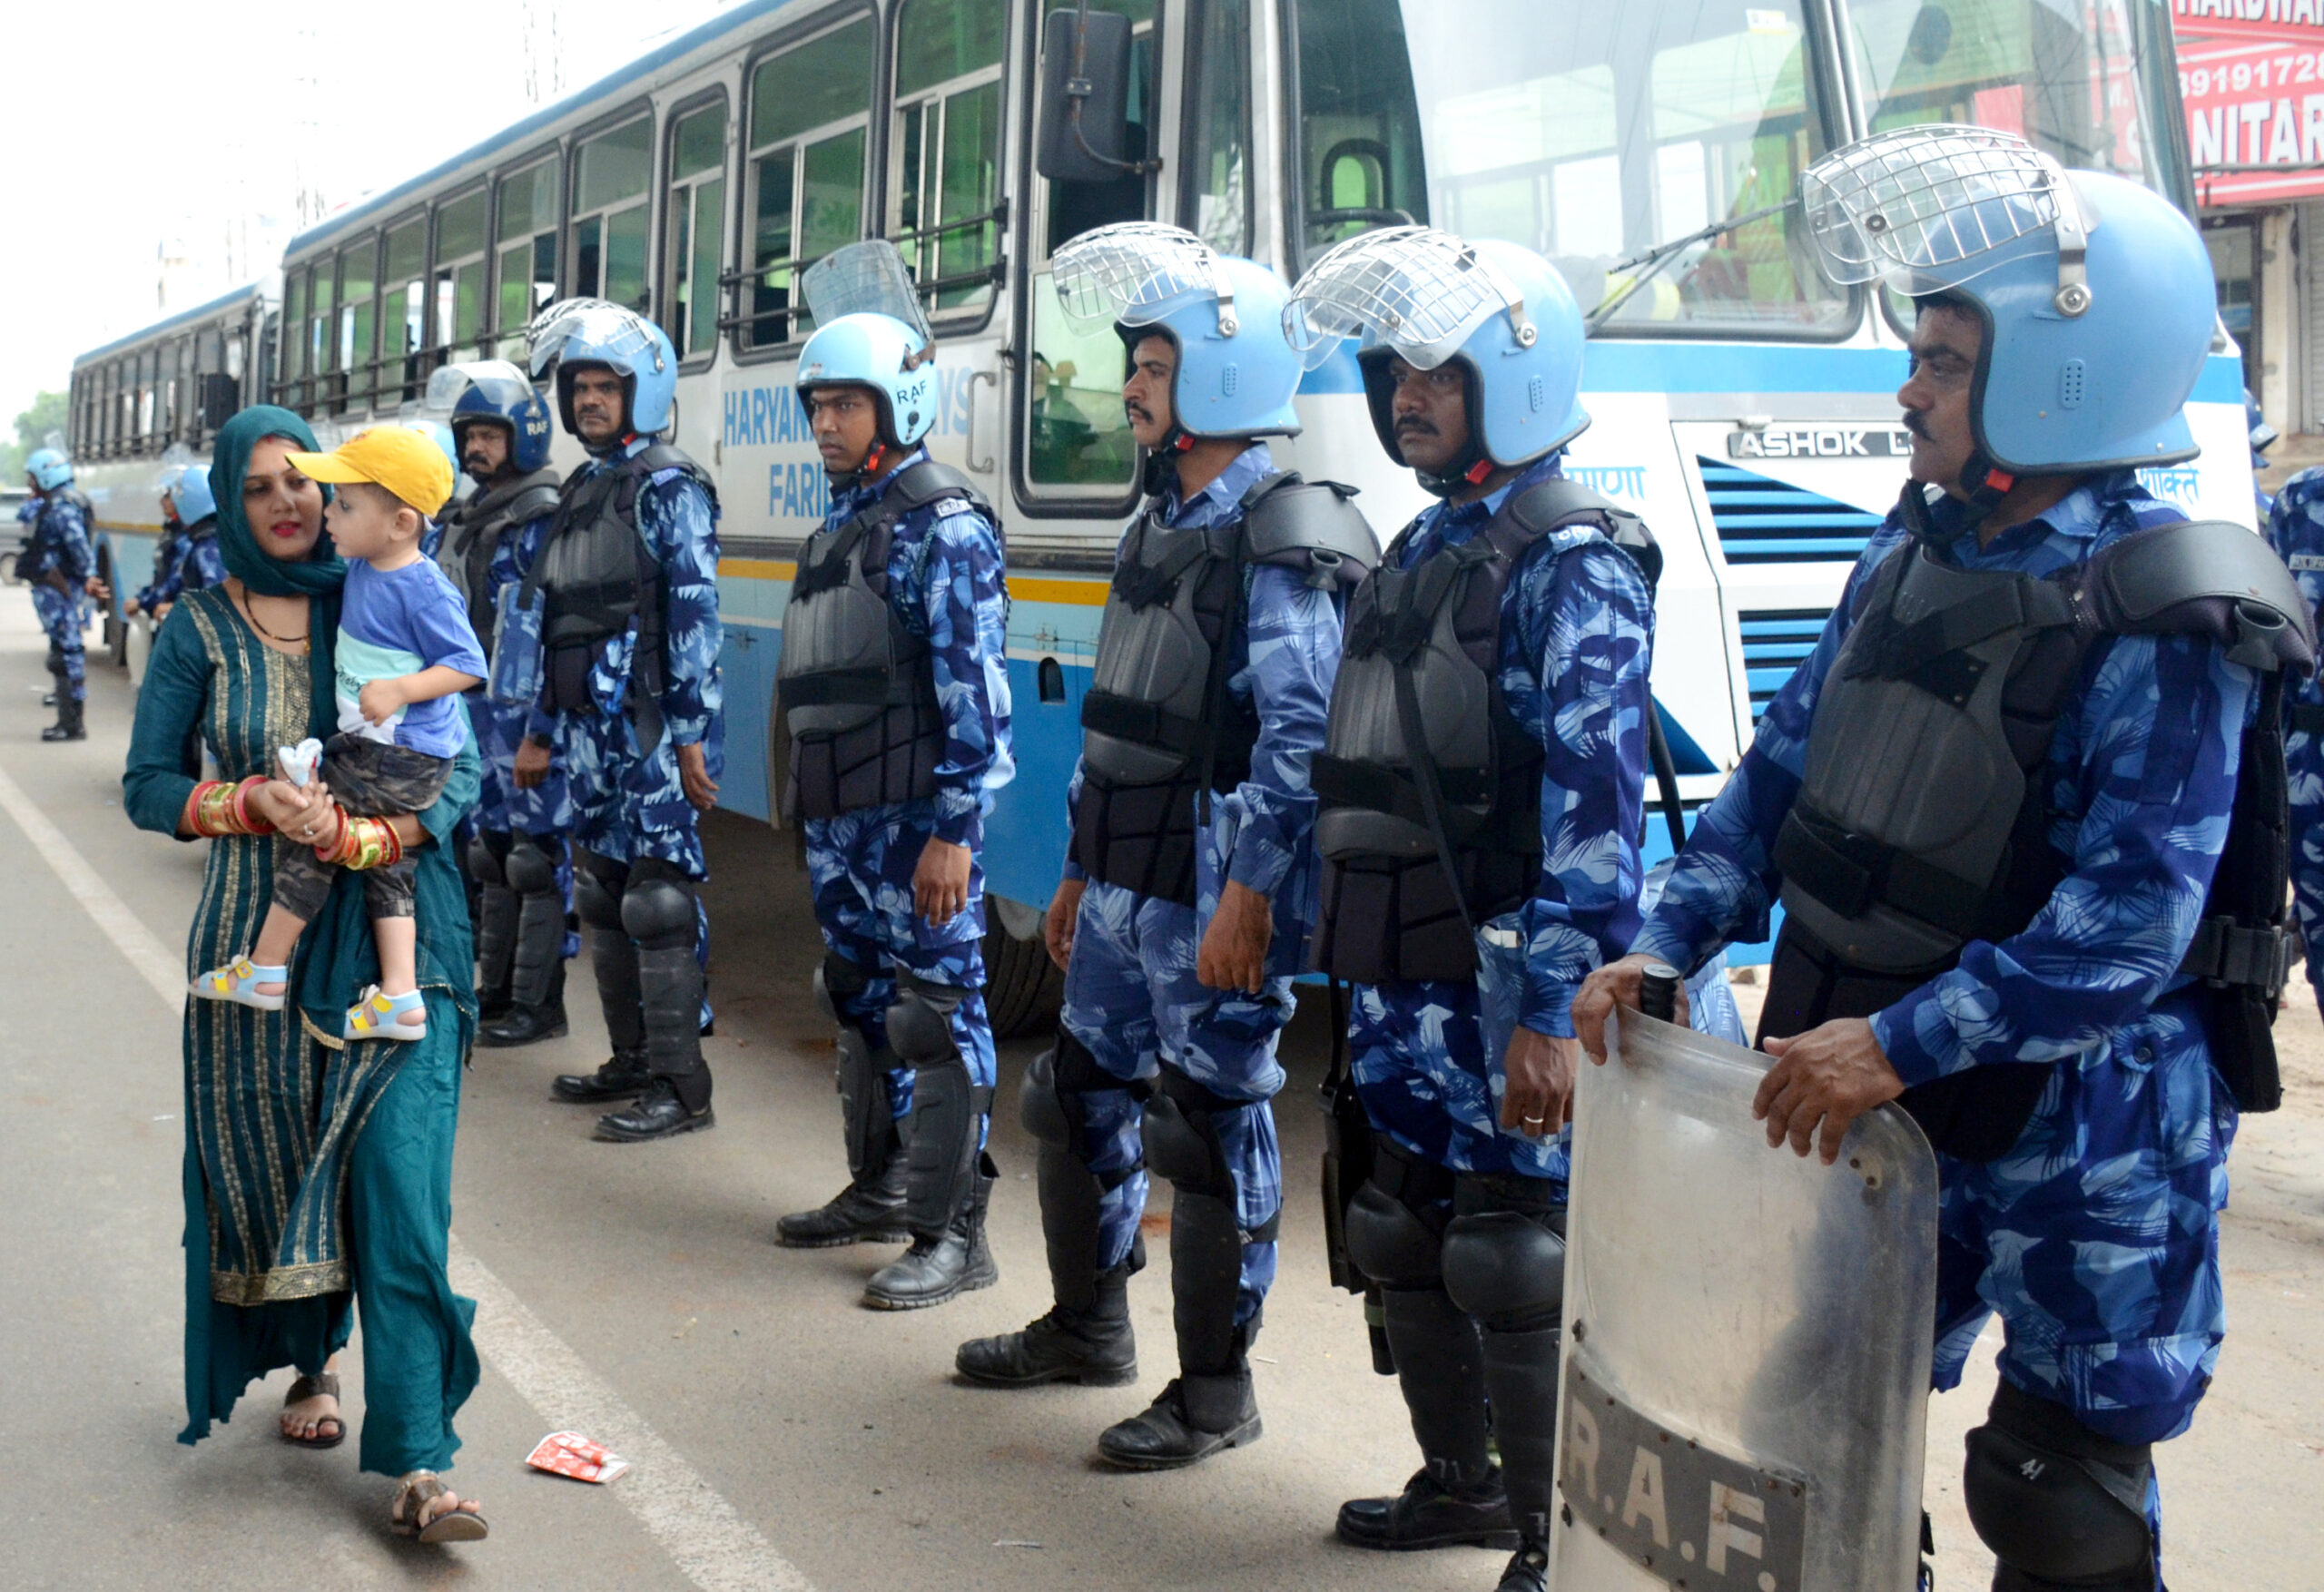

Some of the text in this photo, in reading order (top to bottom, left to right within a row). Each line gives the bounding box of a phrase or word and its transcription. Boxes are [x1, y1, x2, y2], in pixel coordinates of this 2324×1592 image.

[897, 379, 927, 405] RAF
[527, 420, 548, 437] RAF
[724, 385, 814, 447] HARYAN
[1738, 431, 1913, 457] ASHOK L
[1568, 1396, 1777, 1592] R.A.F.
